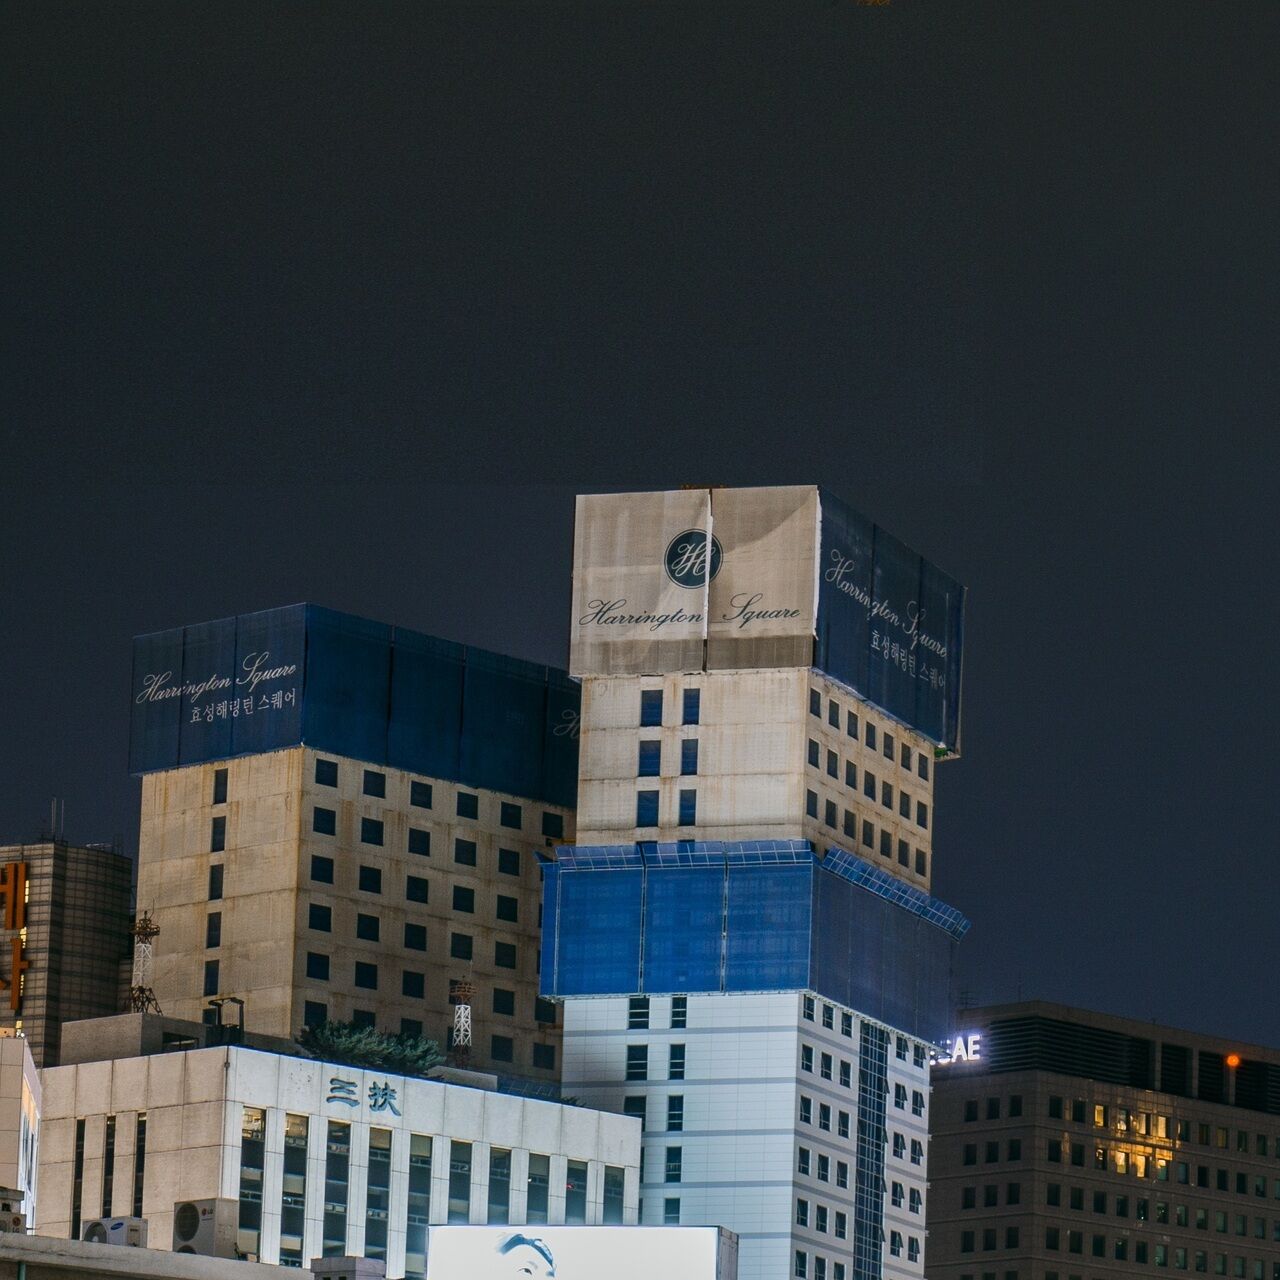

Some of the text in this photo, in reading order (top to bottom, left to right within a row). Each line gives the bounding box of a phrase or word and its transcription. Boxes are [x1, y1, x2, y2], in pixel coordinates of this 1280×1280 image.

[579, 593, 801, 632] Harrington Square
[825, 549, 948, 658] Harrington Square
[136, 651, 297, 704] Harrington Square
